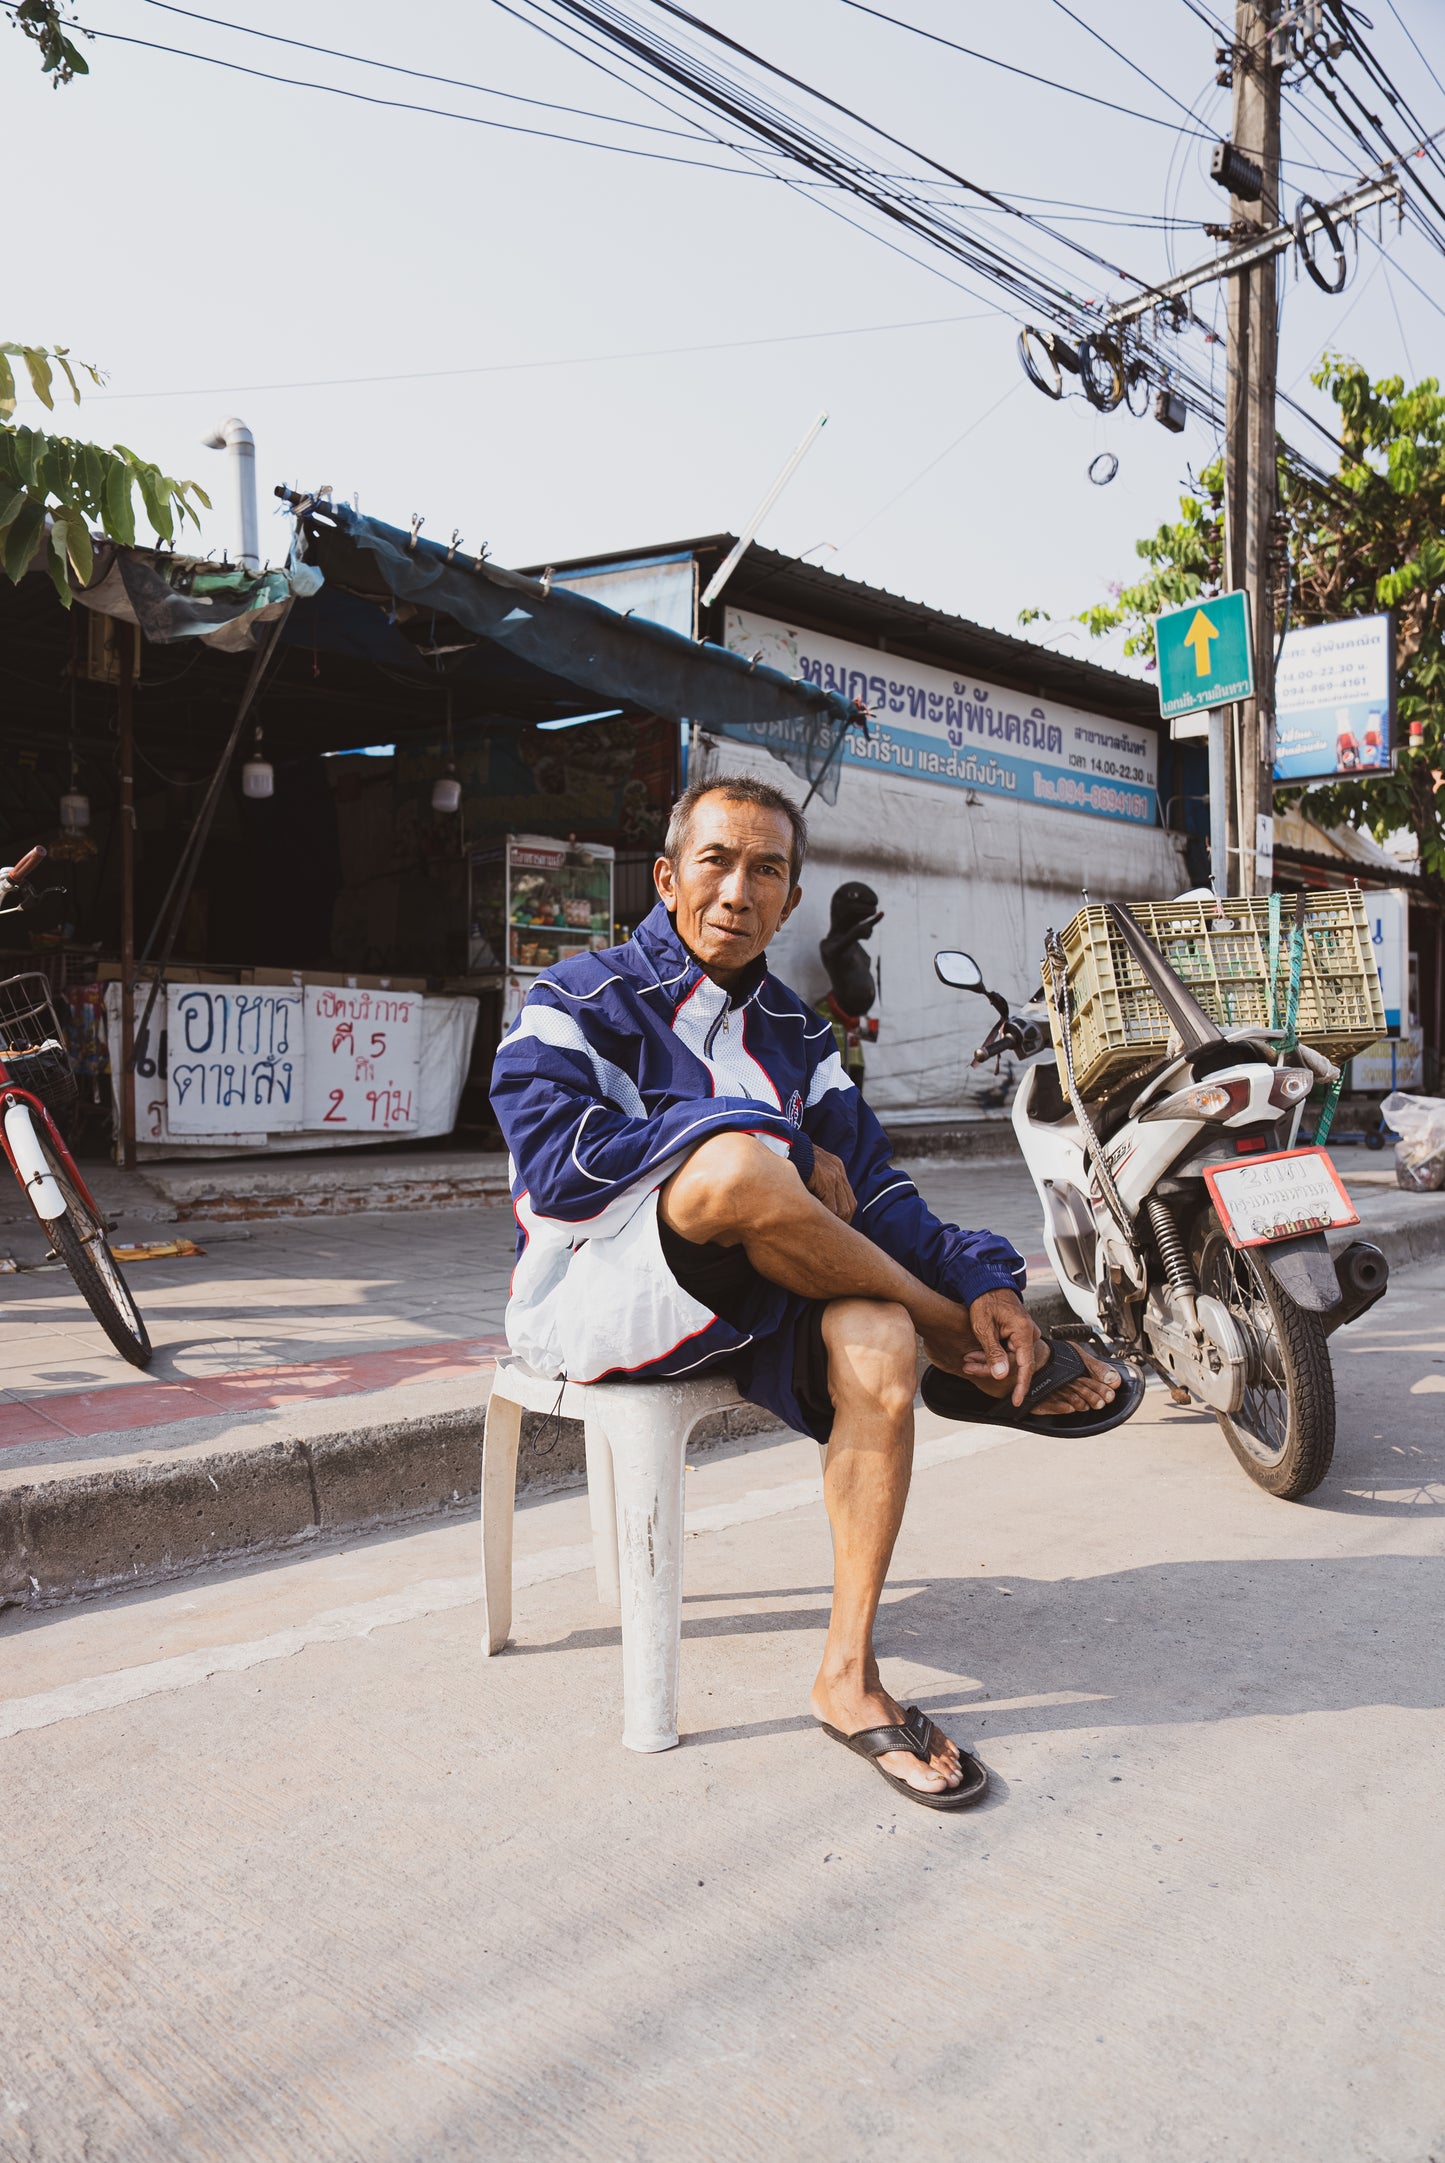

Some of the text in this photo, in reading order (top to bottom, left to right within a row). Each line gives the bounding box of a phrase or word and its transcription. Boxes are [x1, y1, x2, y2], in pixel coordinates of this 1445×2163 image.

[1074, 726, 1146, 756] สาขานวลจันทร์
[918, 745, 1016, 791] และส่งถึงบ้าน
[1069, 754, 1086, 768] เวลา
[1091, 757, 1143, 782] 14.00-22.30
[177, 991, 300, 1054] อาหาร
[331, 1021, 385, 1057] ตี 5
[173, 1054, 292, 1106] ตามสั่ง
[322, 1080, 411, 1128] 2 ทุ่ม
[1275, 1216, 1320, 1236] MAFIA
